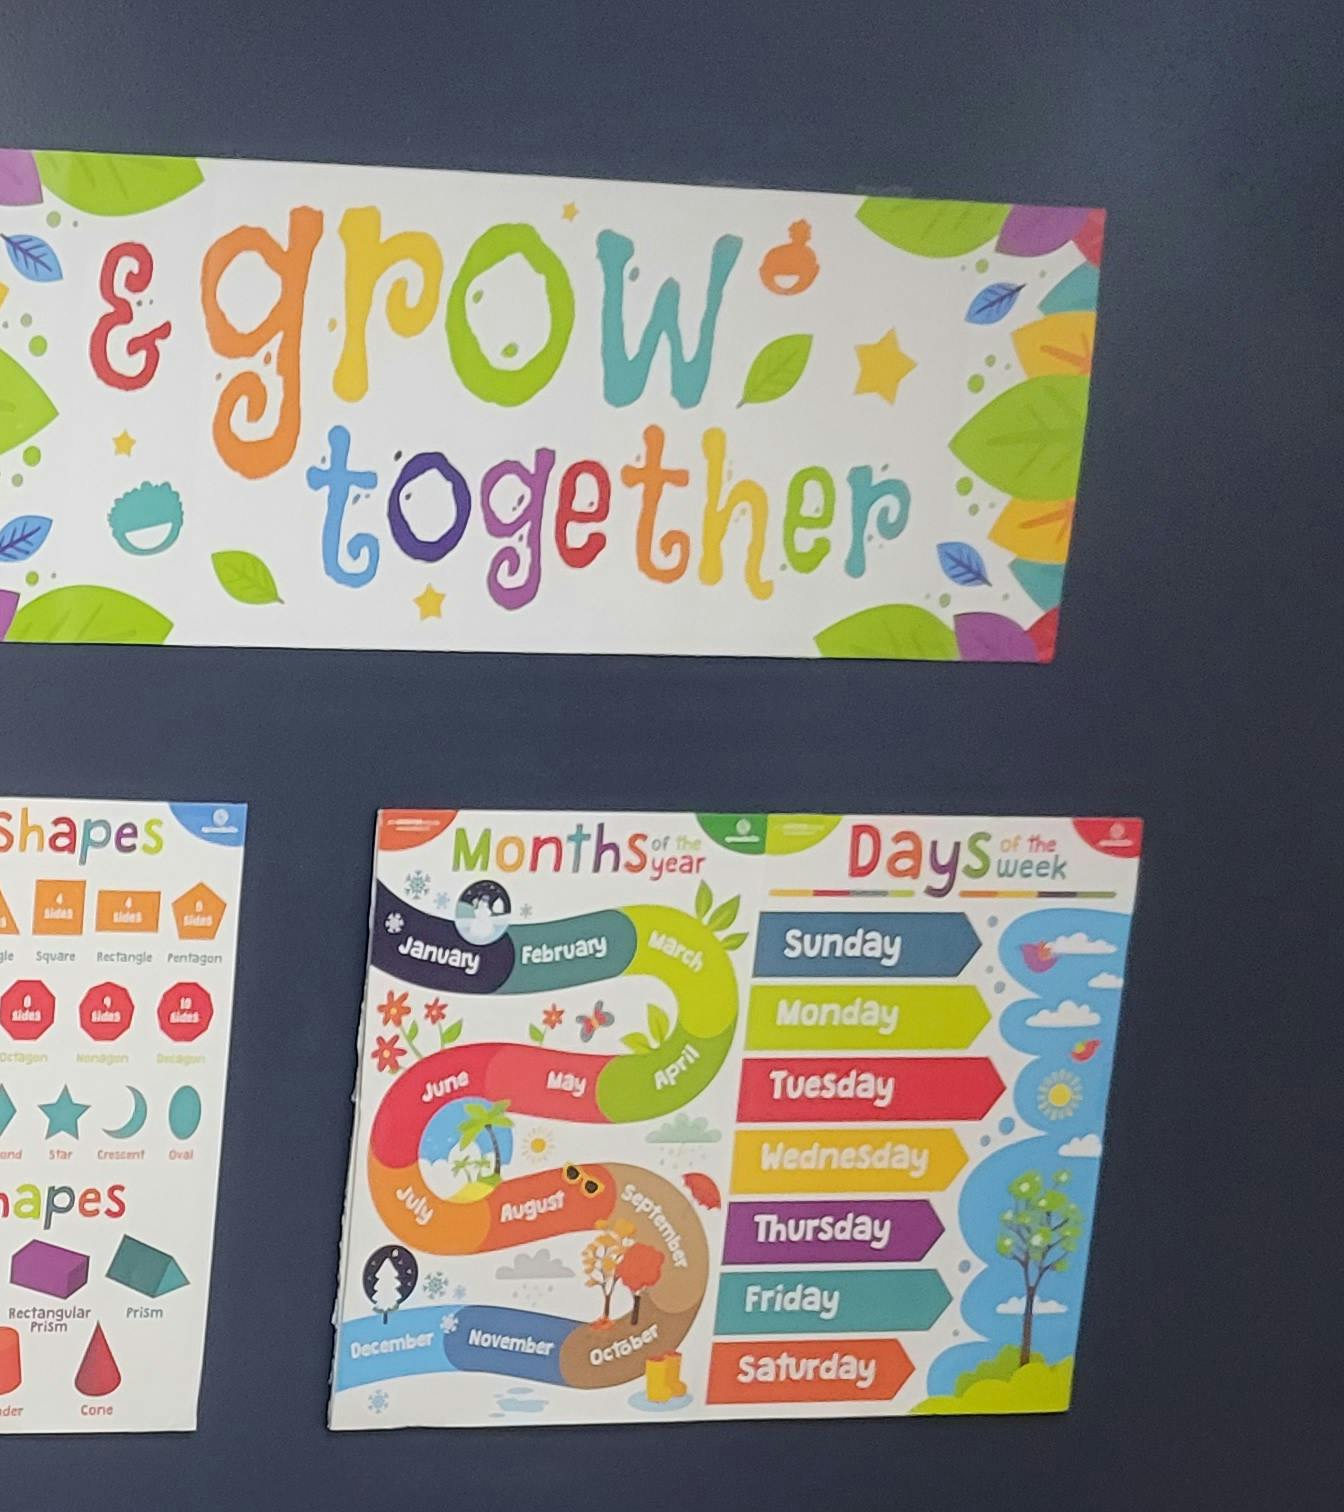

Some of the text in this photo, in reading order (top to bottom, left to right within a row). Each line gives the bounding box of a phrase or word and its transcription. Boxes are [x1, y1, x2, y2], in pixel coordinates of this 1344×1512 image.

[89, 206, 746, 479] & grow
[308, 424, 911, 610] together
[452, 822, 649, 874] Months
[651, 836, 670, 851] of
[676, 835, 702, 851] the
[848, 823, 1056, 898] Days of the
[651, 852, 707, 881] year
[997, 855, 1067, 880] week
[36, 951, 75, 964] Square
[97, 952, 152, 965] Rectangle
[168, 953, 222, 966] Pentagon
[398, 935, 480, 974] January
[521, 935, 607, 965] February
[647, 929, 705, 972] March
[784, 927, 902, 967] Sunday
[776, 997, 899, 1035] Monday
[547, 1071, 587, 1096] May
[653, 1043, 700, 1090] April
[422, 1071, 469, 1102] June
[769, 1069, 895, 1108] Tuesday
[49, 1149, 73, 1160] Star
[169, 1149, 194, 1160] Oval
[761, 1142, 929, 1178] Wednesday
[396, 1186, 434, 1226] July
[500, 1189, 565, 1223] August
[621, 1183, 689, 1269] September
[754, 1212, 891, 1250] Thursday
[8, 1306, 92, 1321] Rectangular
[126, 1307, 163, 1319] Prism
[745, 1282, 840, 1319] Friday
[30, 1320, 68, 1333] Prism
[468, 1328, 555, 1357] November
[350, 1330, 434, 1360] December
[589, 1324, 659, 1367] October
[736, 1352, 876, 1388] Saturday
[80, 1404, 113, 1417] Cone
